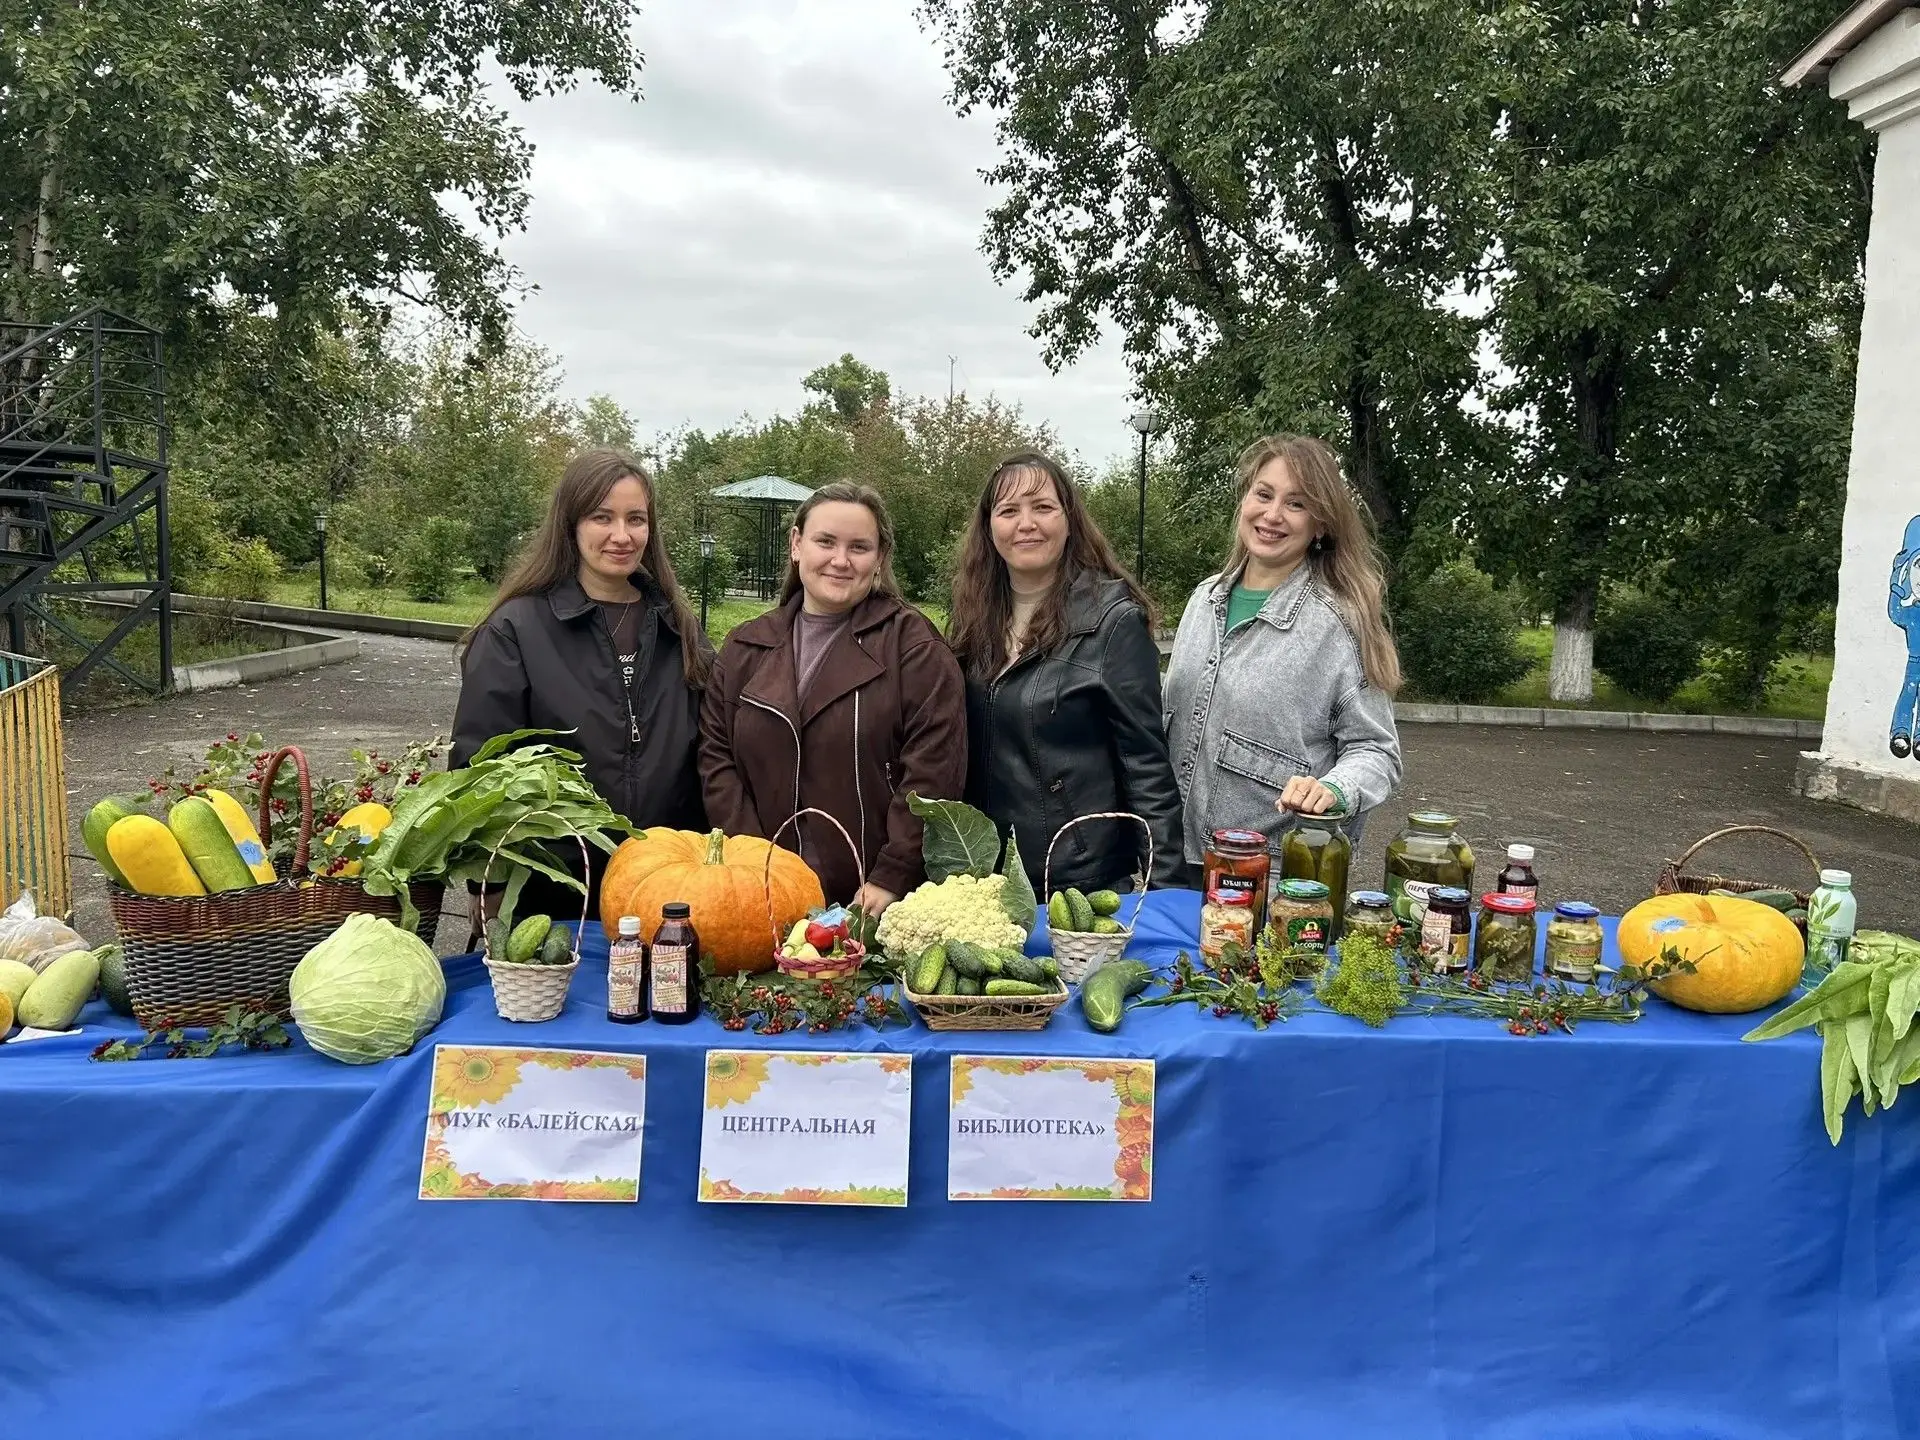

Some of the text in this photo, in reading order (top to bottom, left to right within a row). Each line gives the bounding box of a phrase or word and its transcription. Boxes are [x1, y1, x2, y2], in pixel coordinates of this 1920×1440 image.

[1407, 884, 1427, 894] ПЕРС
[440, 1111, 638, 1131] МУК «БАЛЕЙСКАЯ
[721, 1116, 876, 1135] ЦЕНТРАЛЬНАЯ
[957, 1119, 1106, 1135] БИБЛИОТЕКА»
